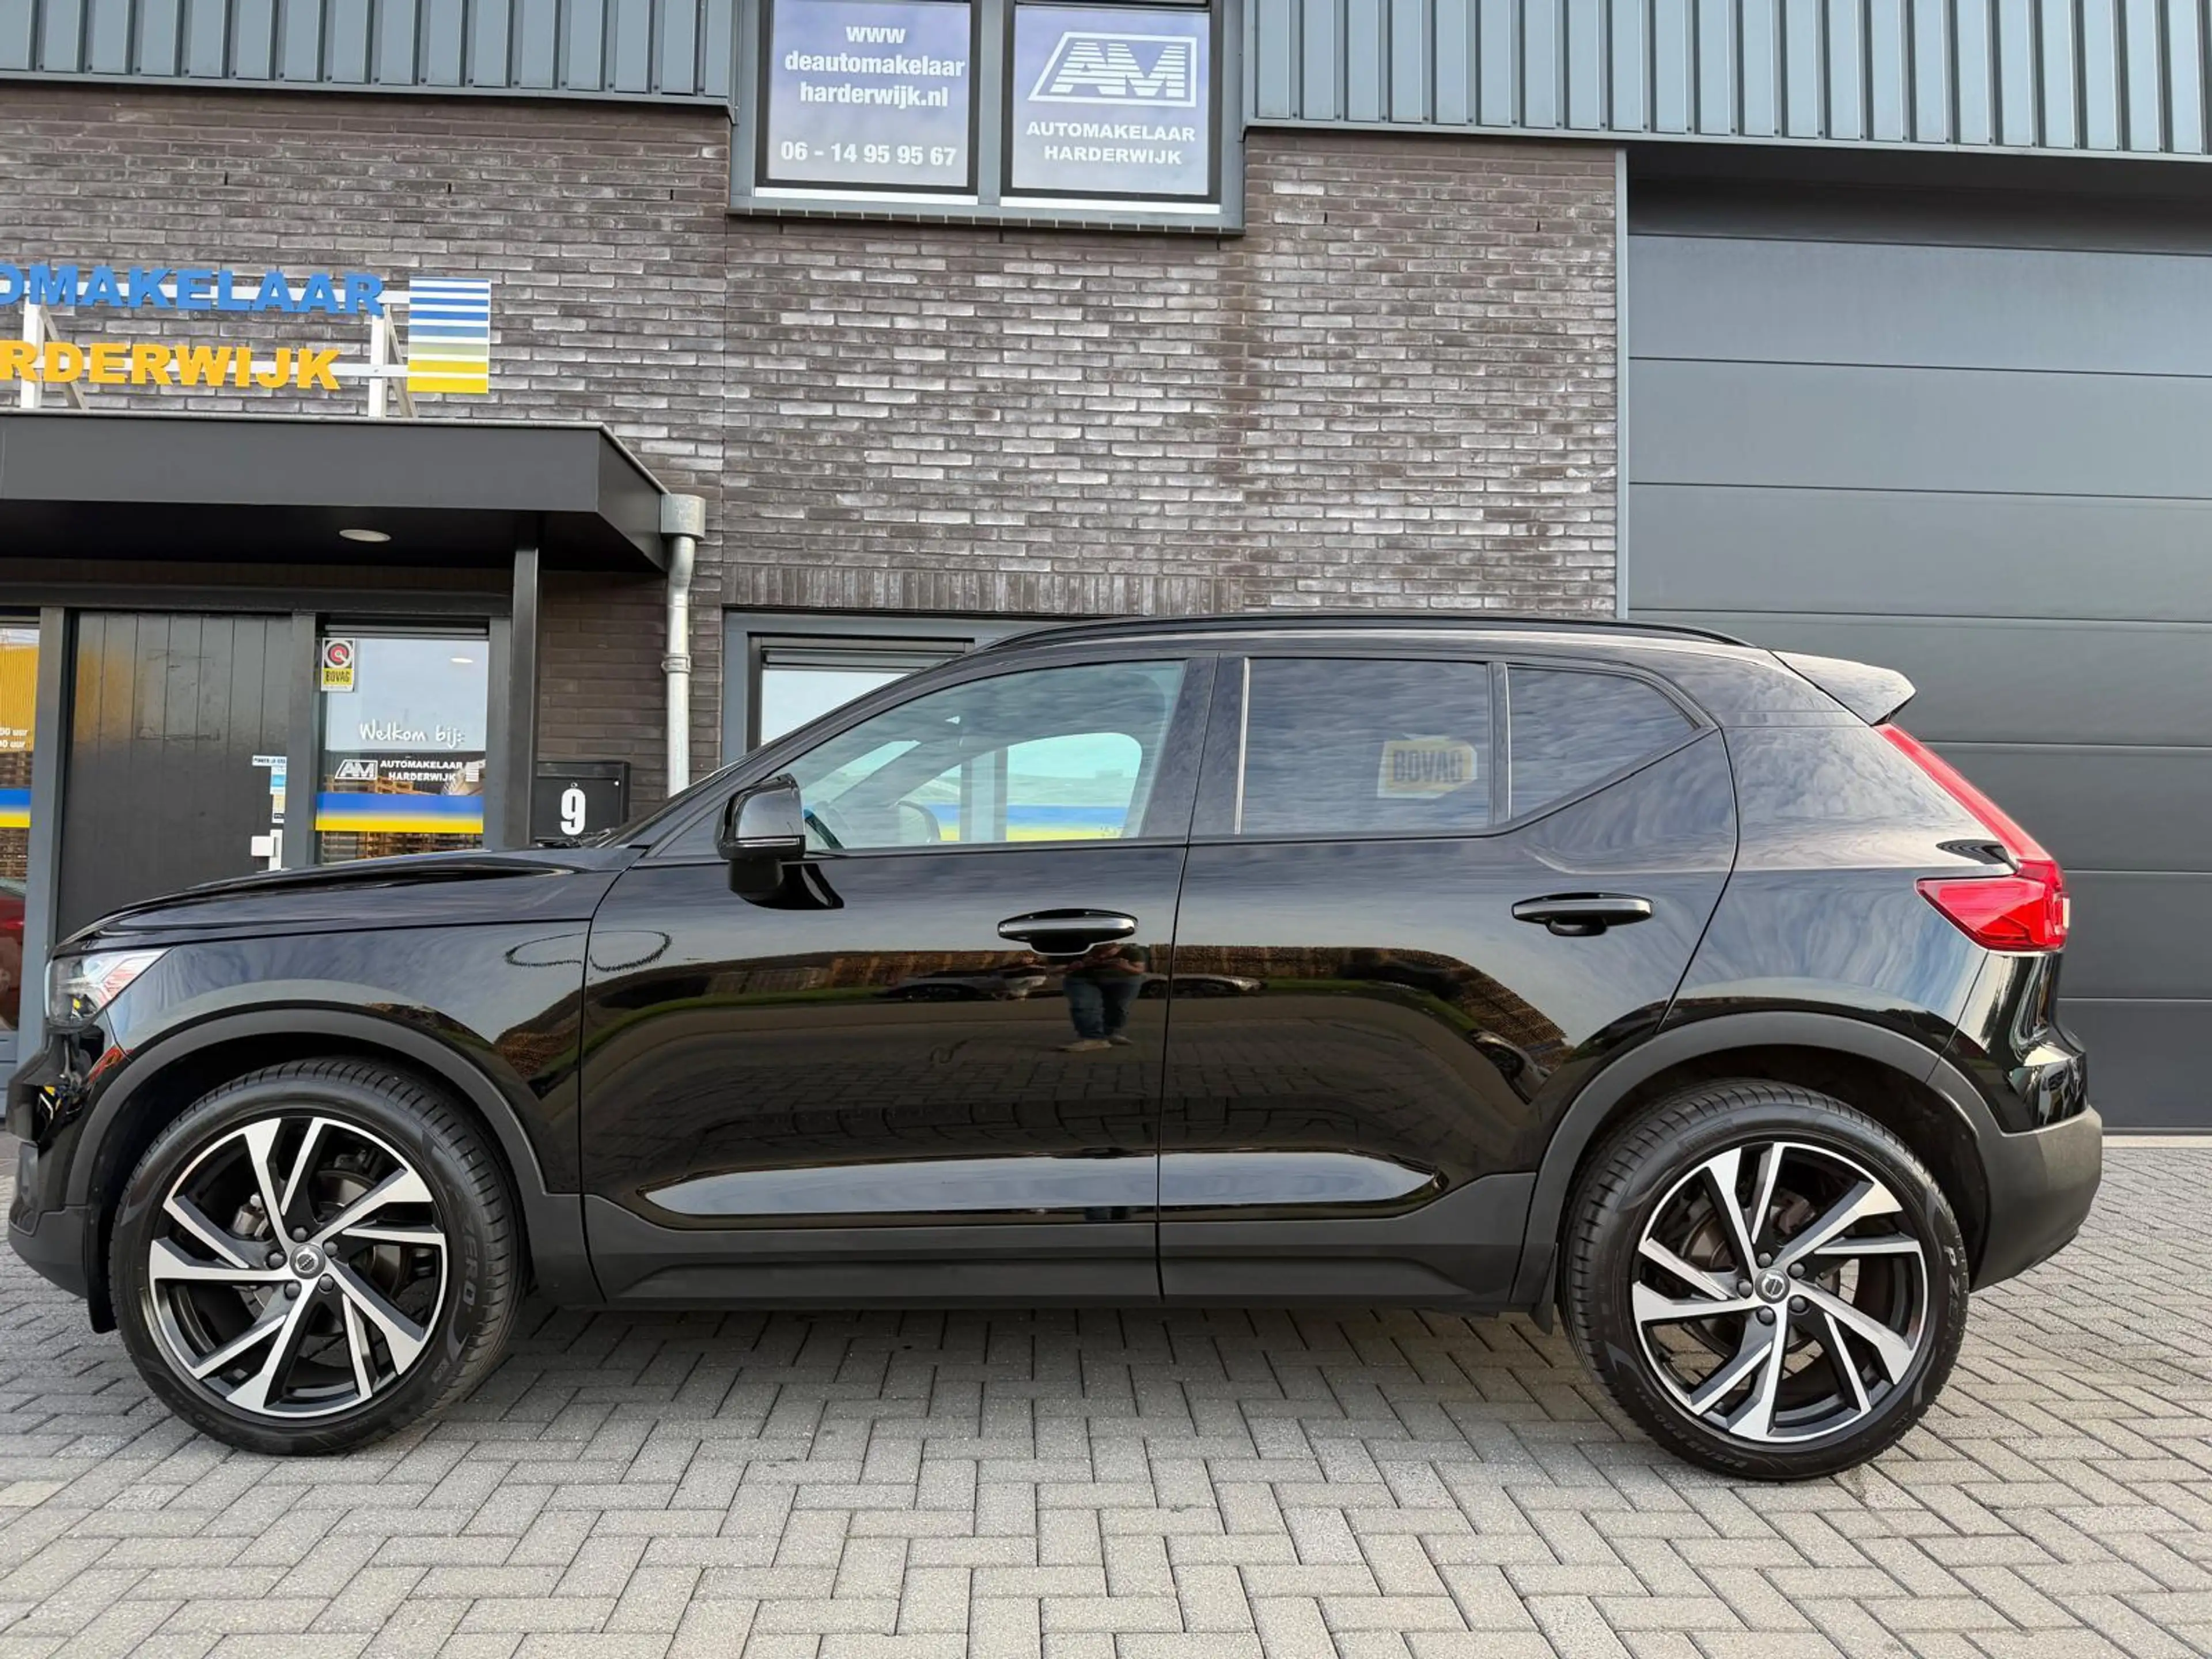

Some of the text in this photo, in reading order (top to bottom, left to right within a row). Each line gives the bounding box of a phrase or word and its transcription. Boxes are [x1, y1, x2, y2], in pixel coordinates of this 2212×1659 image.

[846, 26, 906, 43] www
[784, 50, 966, 77] deautomakelaar
[800, 81, 949, 109] harderwijk.nl
[1025, 121, 1196, 142] AUTOMAKELAAR
[780, 141, 808, 161] 06
[831, 143, 858, 162] 14
[863, 144, 891, 164] 95
[897, 145, 923, 165] 95
[929, 146, 957, 166] 67
[1043, 145, 1183, 165] HARDERWIJK
[359, 718, 463, 750] Welkom bij:
[380, 759, 463, 770] AUTOMAKELAAR
[388, 771, 456, 782] HARDERWIJK
[1393, 749, 1464, 783] BOVAG
[560, 787, 586, 836] 9
